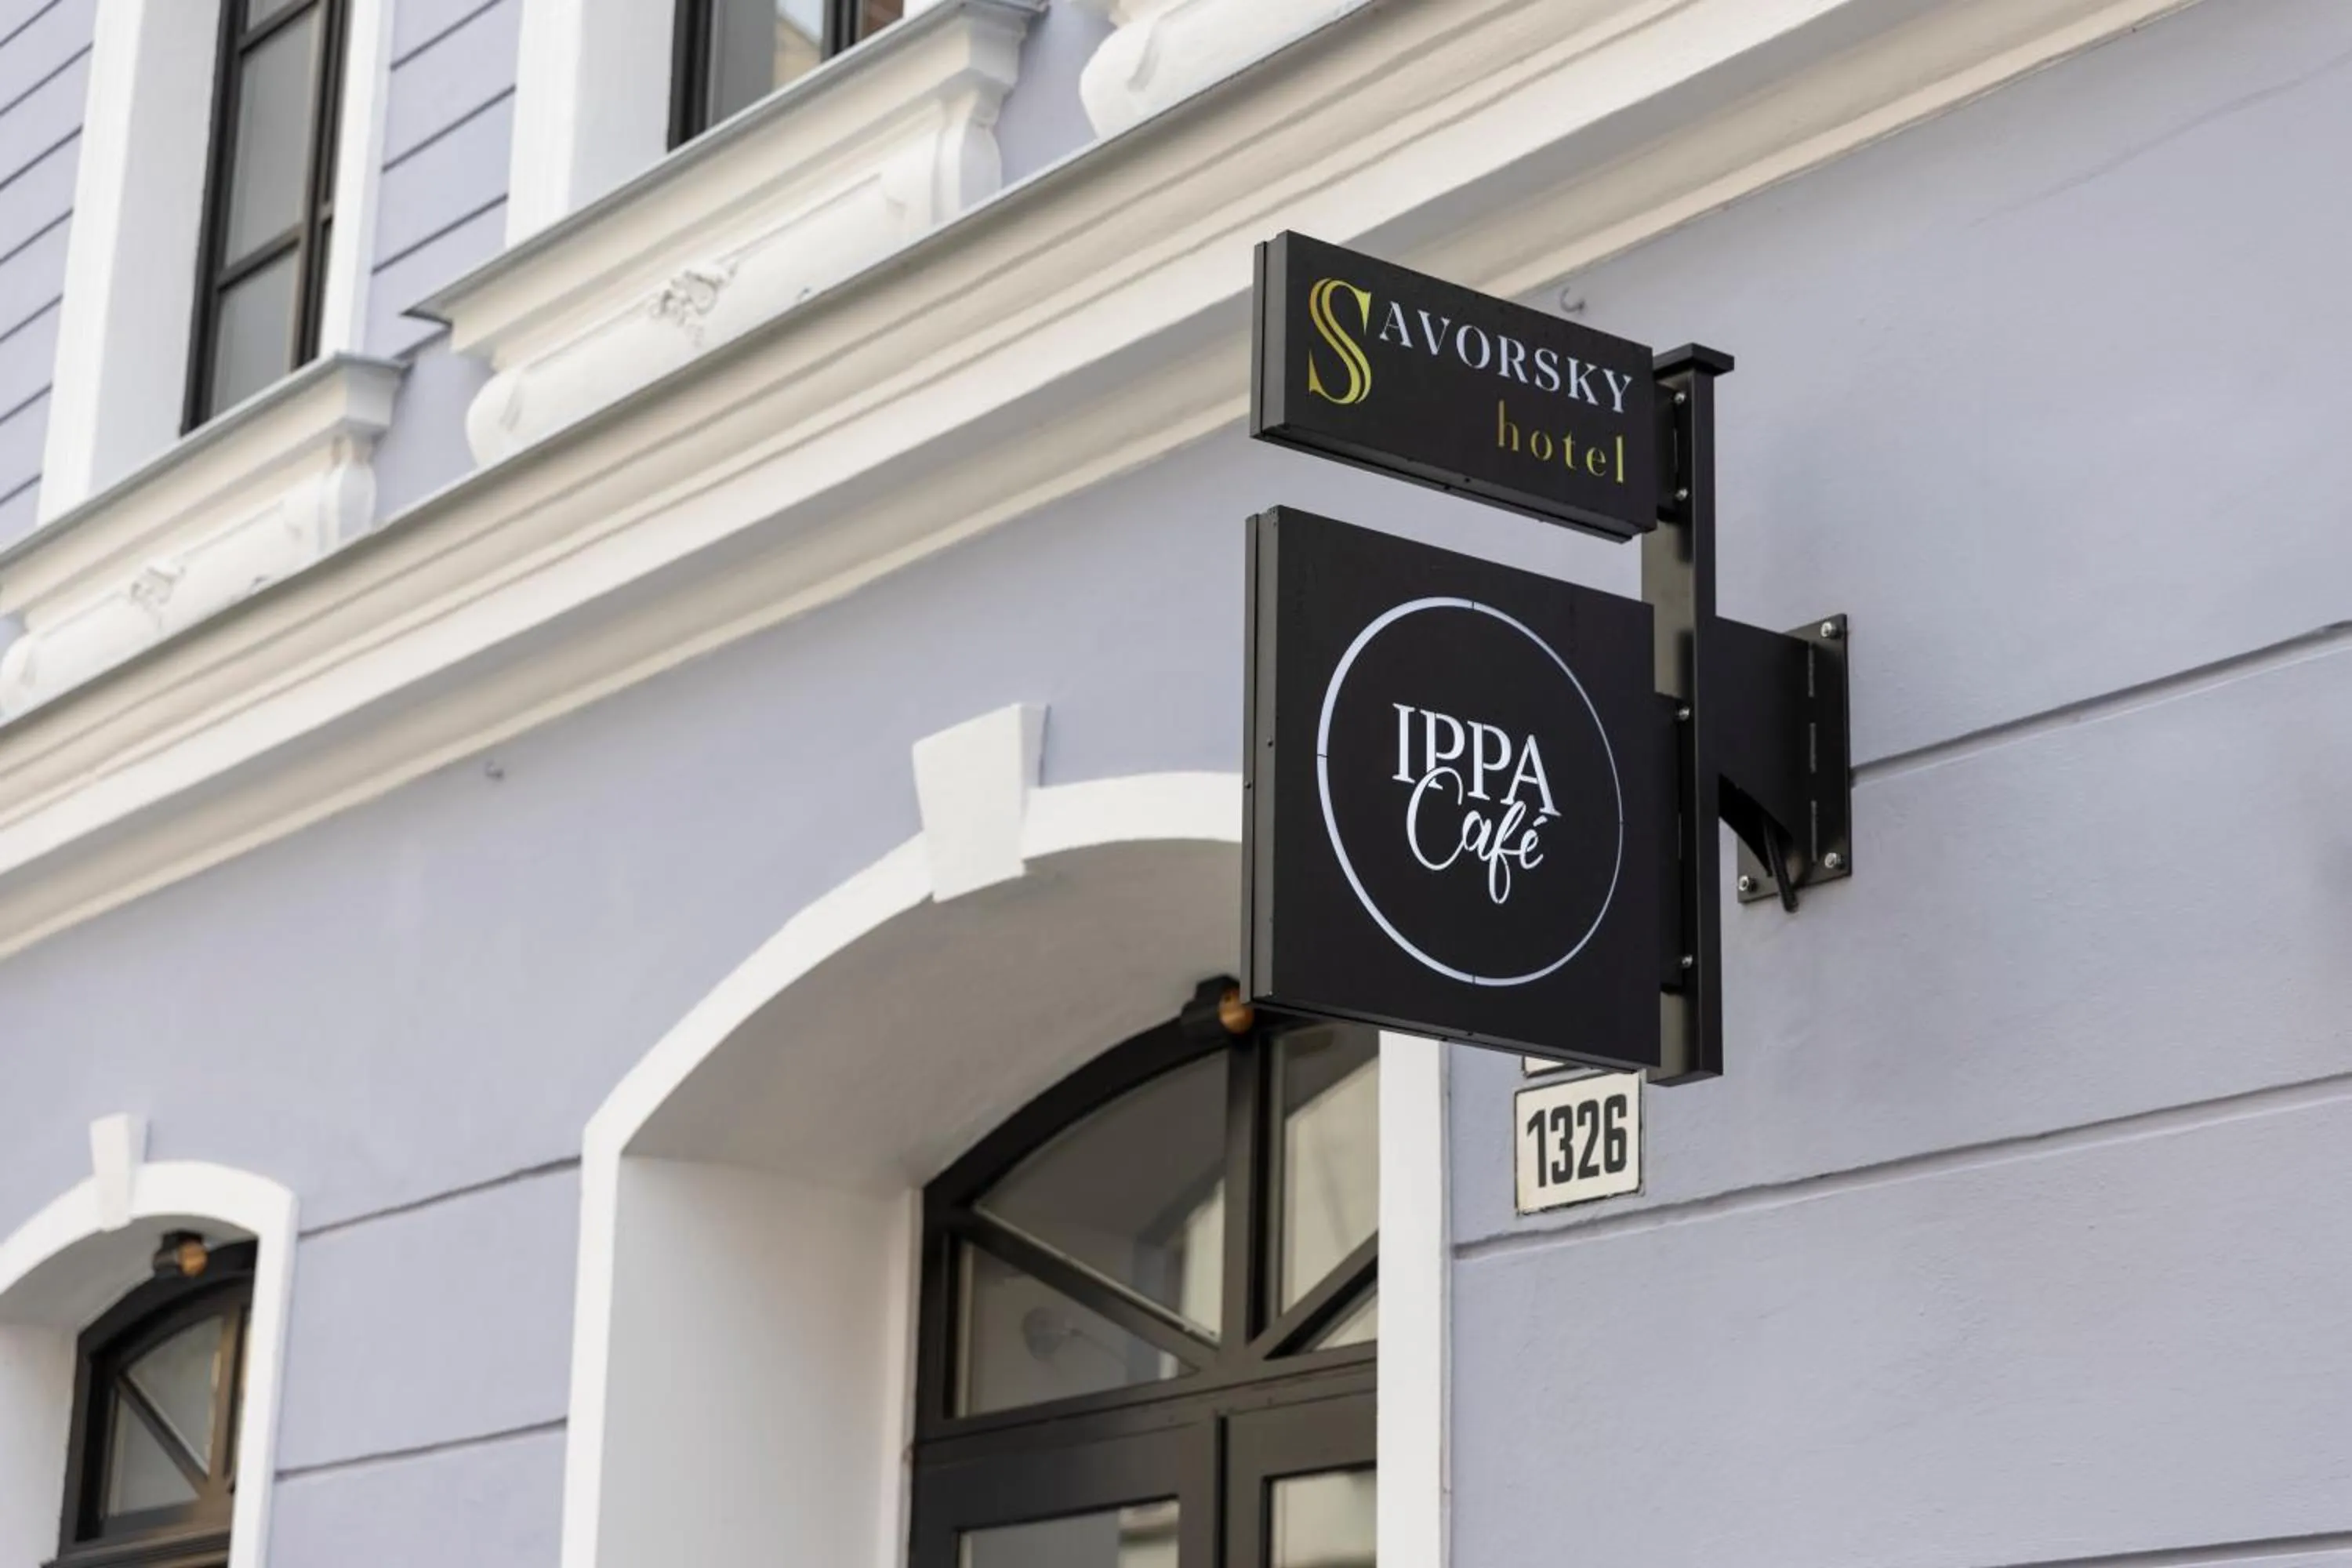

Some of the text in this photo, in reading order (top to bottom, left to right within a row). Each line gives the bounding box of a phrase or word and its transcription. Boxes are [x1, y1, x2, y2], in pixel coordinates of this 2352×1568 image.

[1308, 278, 1633, 414] SAVORSKY
[1497, 400, 1624, 484] hotel
[1392, 702, 1562, 817] IPPA
[1406, 766, 1548, 904] Café
[1526, 1094, 1628, 1189] 1326
